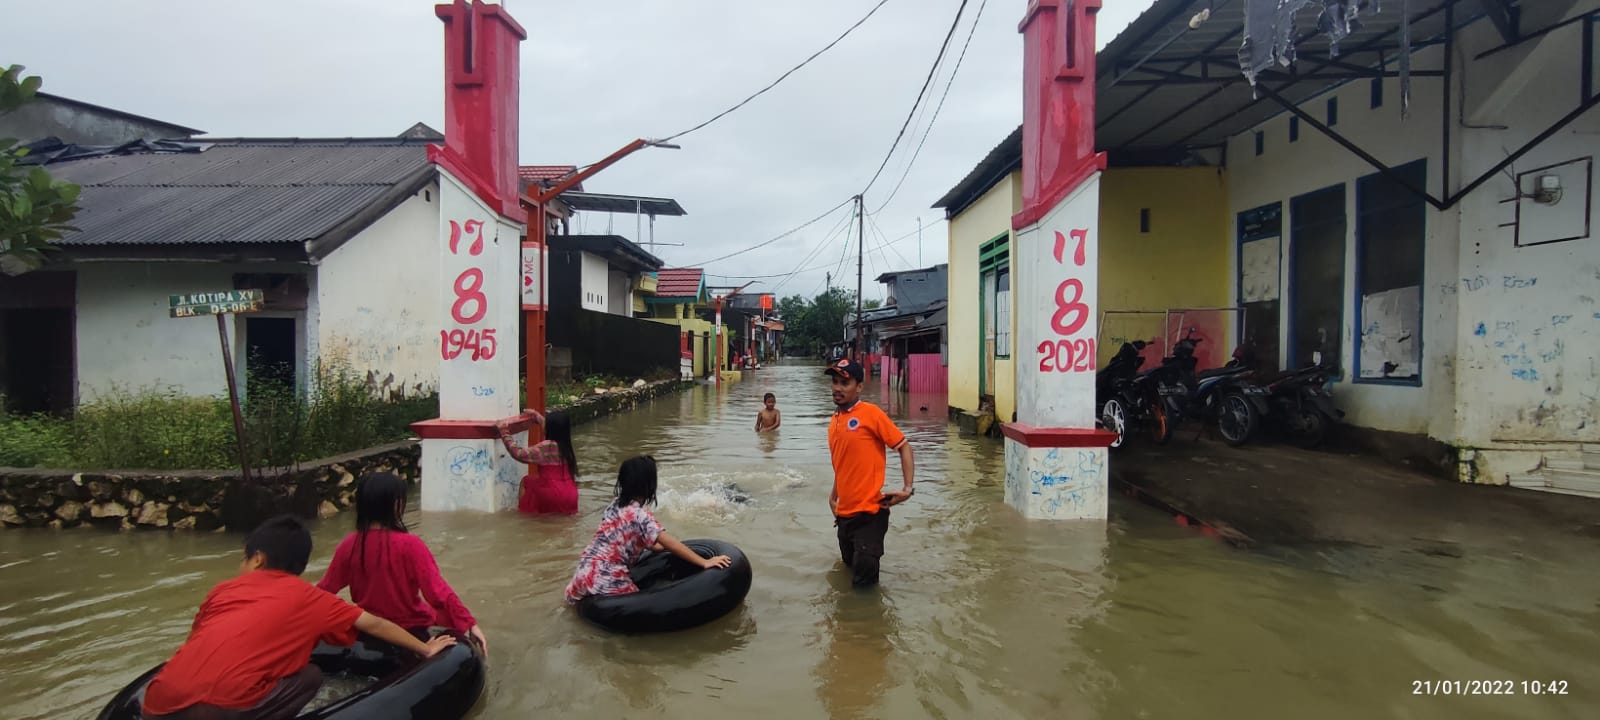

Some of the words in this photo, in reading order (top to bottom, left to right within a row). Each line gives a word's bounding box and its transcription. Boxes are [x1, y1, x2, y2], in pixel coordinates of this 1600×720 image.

[449, 219, 485, 256] 17
[1053, 228, 1089, 266] 17
[239, 291, 254, 301] XV
[451, 267, 487, 324] 8
[1050, 278, 1089, 336] 8
[440, 329, 497, 361] 1945
[1037, 337, 1096, 373] 2021
